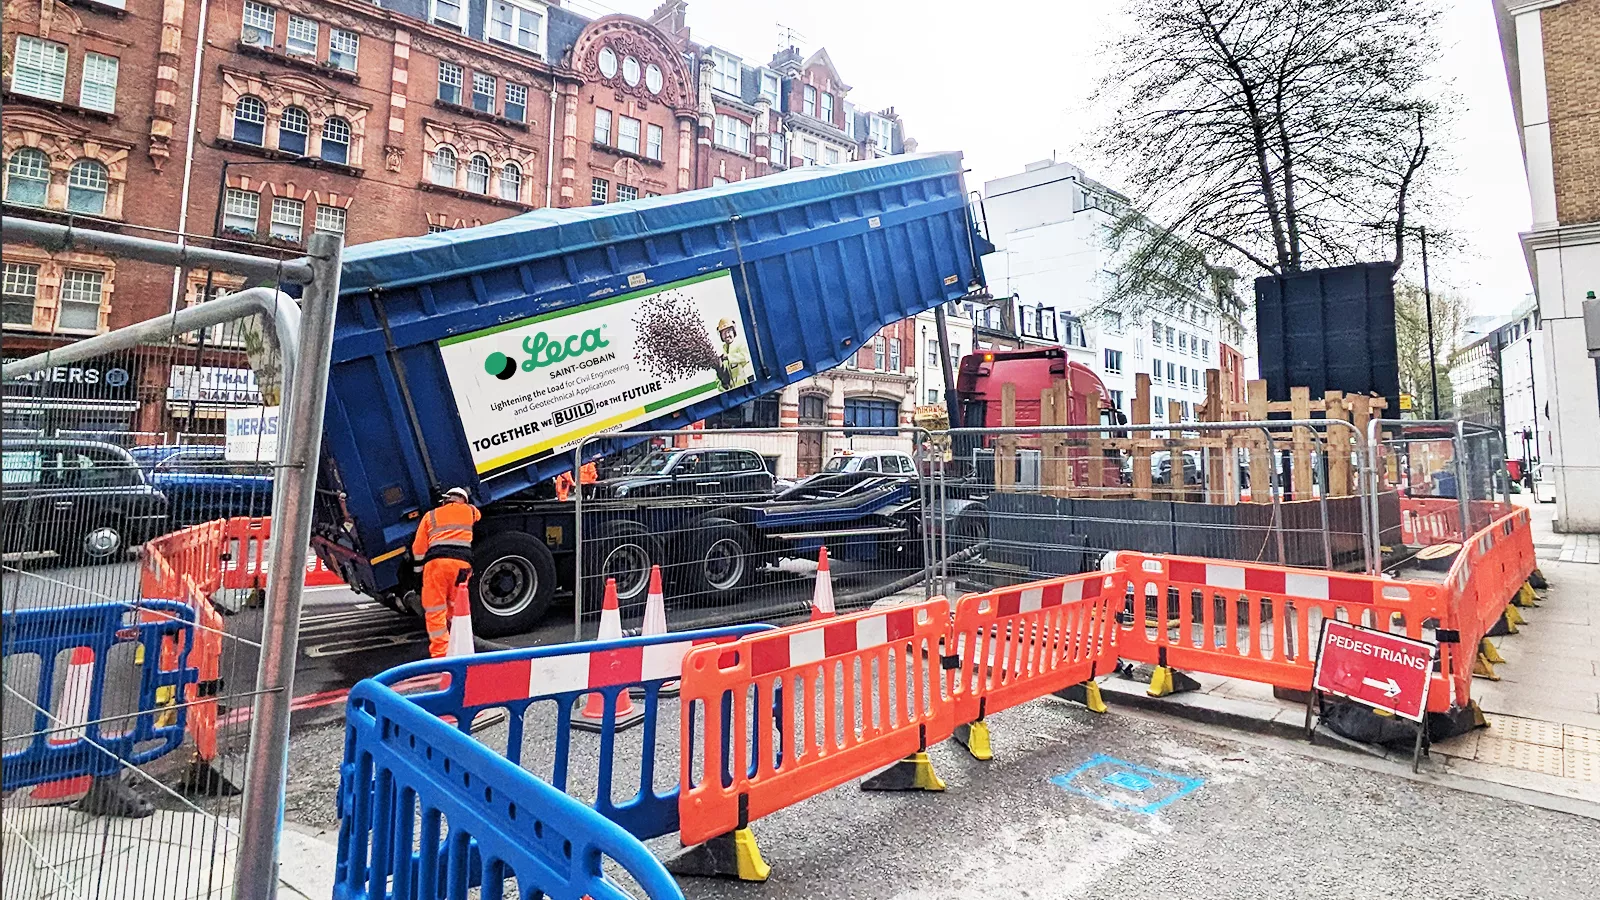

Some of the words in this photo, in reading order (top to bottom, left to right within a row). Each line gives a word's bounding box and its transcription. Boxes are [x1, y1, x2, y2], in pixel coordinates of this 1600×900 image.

[521, 327, 610, 373] Leca
[549, 351, 616, 380] SAINT-GOBAIN
[490, 392, 533, 412] Lightening
[532, 389, 546, 399] the
[546, 382, 565, 394] Load
[565, 379, 576, 389] for
[575, 373, 590, 385] Civil
[591, 363, 630, 380] Engineering
[514, 406, 529, 416] and
[529, 390, 575, 411] Geotechnical
[575, 377, 616, 396] Applications
[236, 416, 278, 436] HERAS
[472, 421, 540, 452] TOGETHER
[540, 418, 553, 428] WE
[554, 402, 594, 425] BUILD
[596, 400, 609, 409] FOR
[610, 394, 622, 404] THE
[622, 380, 663, 402] FUTURE
[1327, 633, 1425, 670] PEDESTRIANS
